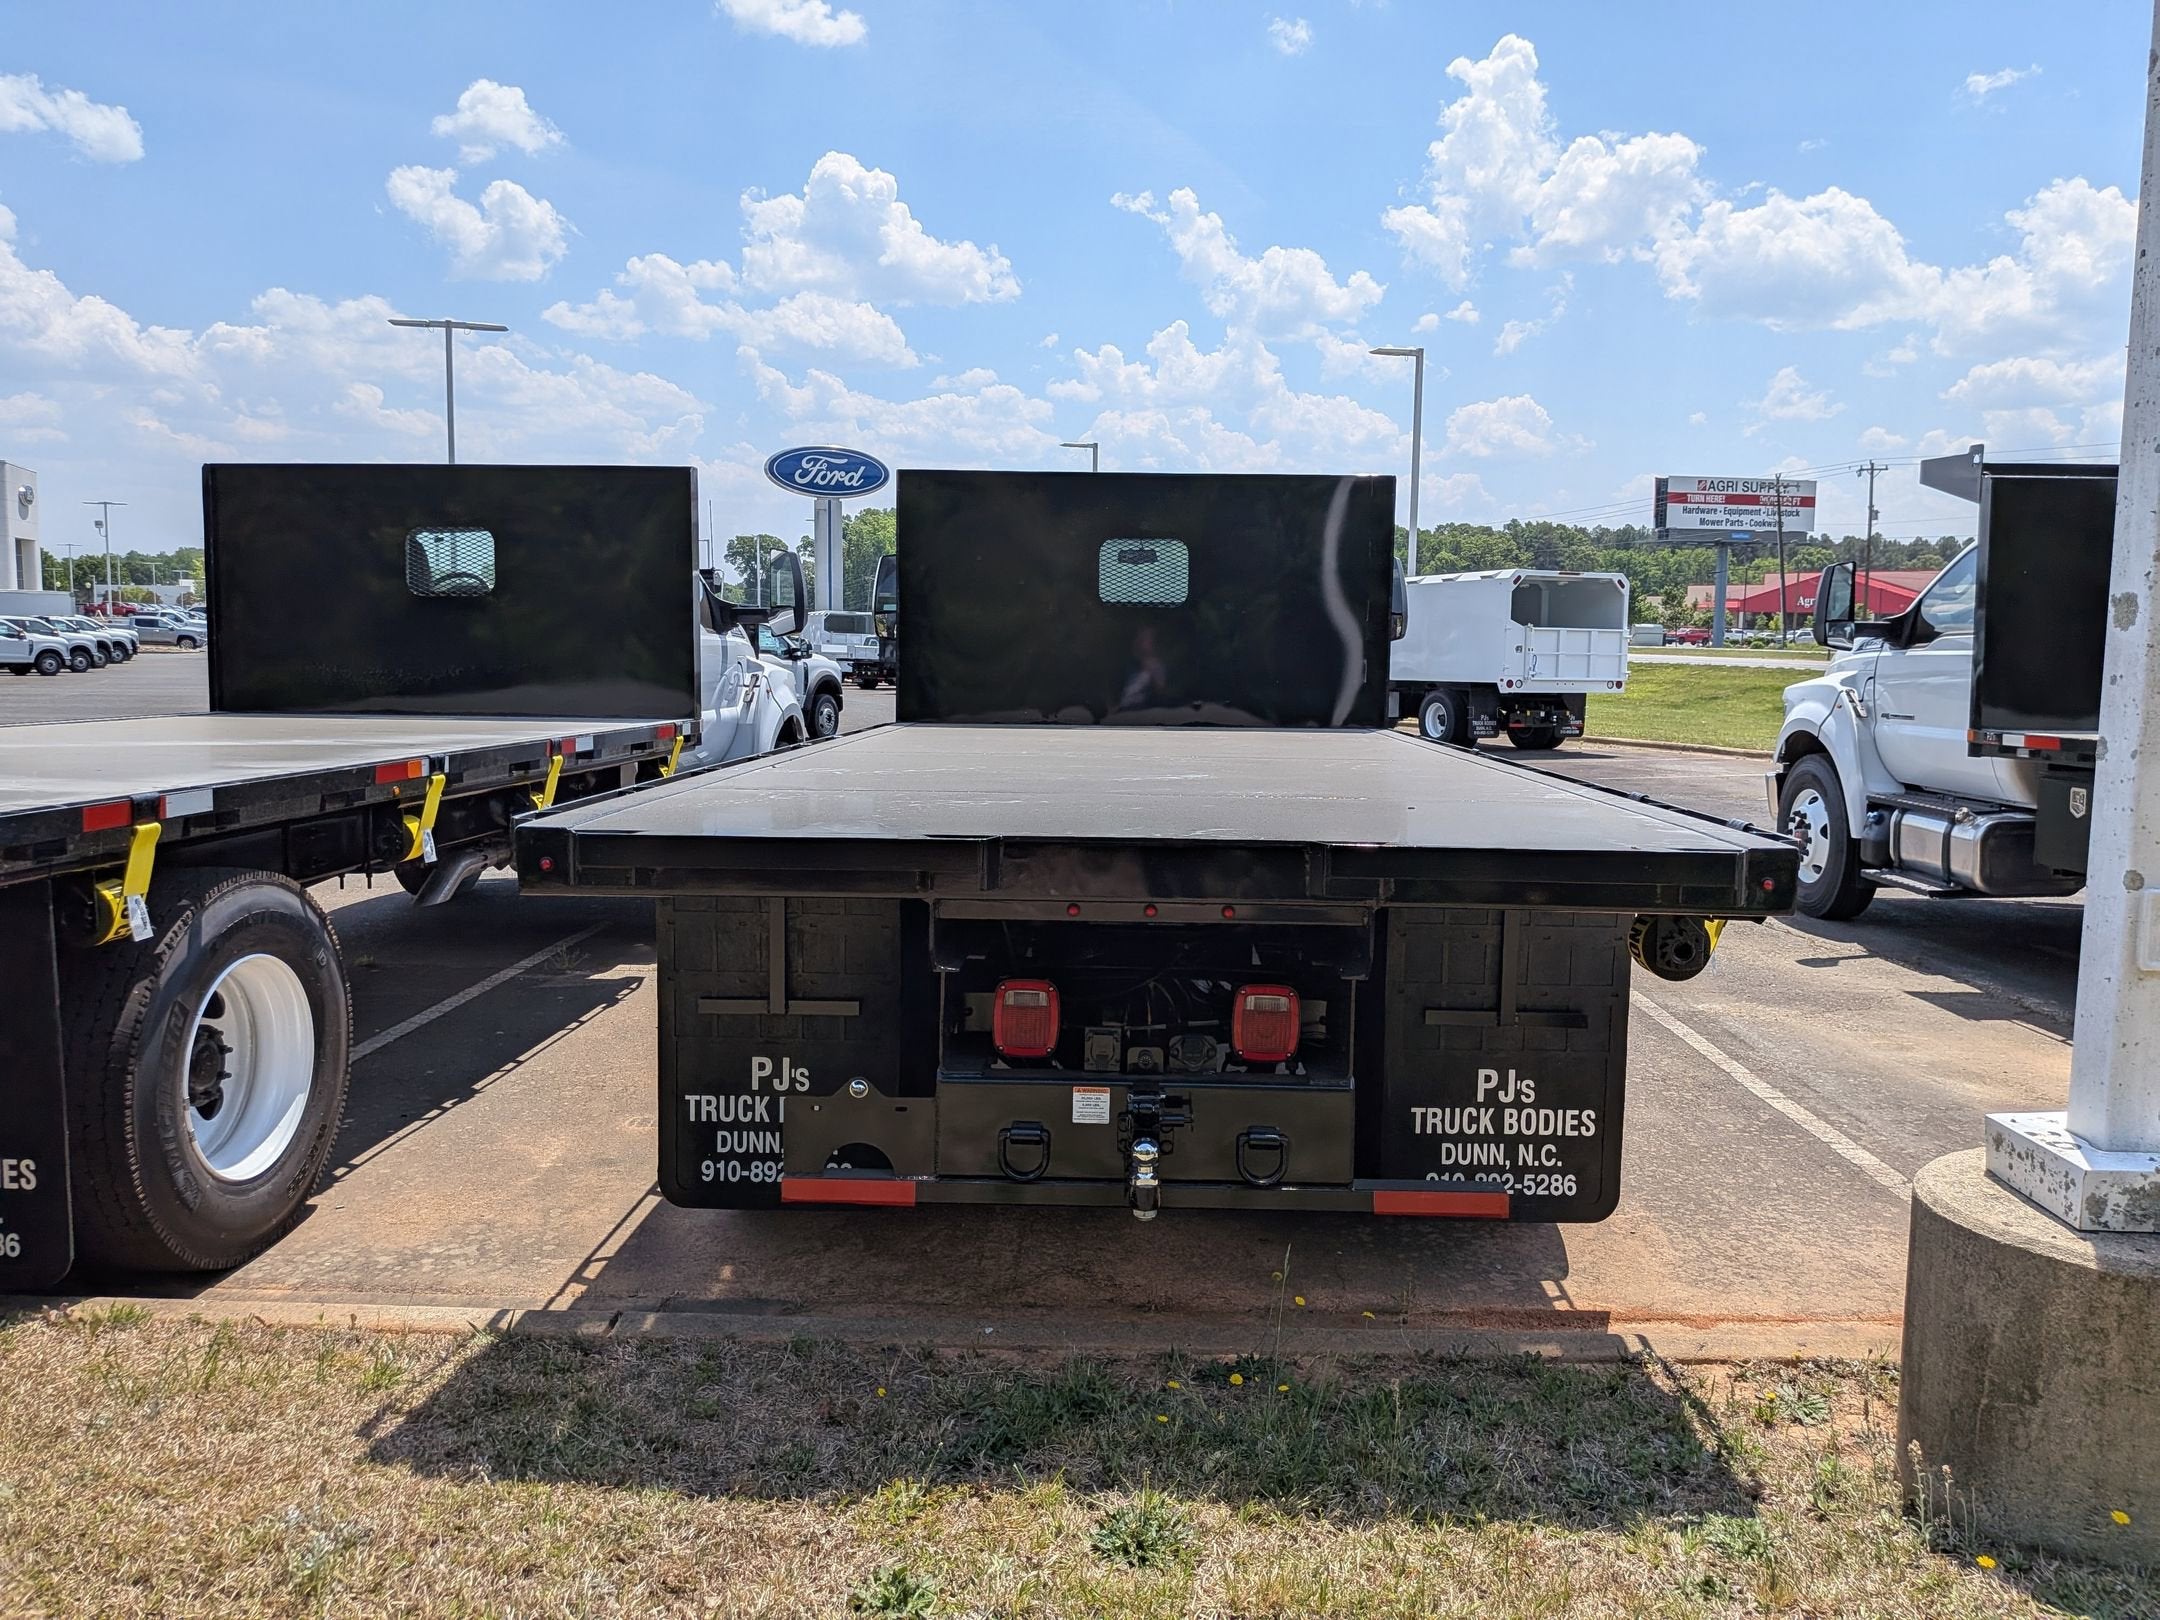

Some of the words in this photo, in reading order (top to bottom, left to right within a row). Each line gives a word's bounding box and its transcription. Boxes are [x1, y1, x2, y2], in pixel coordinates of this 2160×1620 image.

[795, 455, 865, 486] Ford
[1707, 480, 1738, 492] AGRI
[1687, 494, 1705, 503] TURN
[1706, 494, 1726, 503] HERE!
[1682, 506, 1718, 515] Hardware
[1723, 507, 1761, 517] Equipment
[1767, 508, 1800, 517] Livstock
[1699, 518, 1724, 527] Mower
[1725, 518, 1744, 527] Parts
[1749, 519, 1784, 528] Cookwae
[685, 1095, 770, 1123] TRUCK
[1410, 1107, 1495, 1135] TRUCK
[1504, 1108, 1596, 1137] BODIES
[1441, 1143, 1511, 1170] DUNN,
[1518, 1144, 1562, 1167] N.C.
